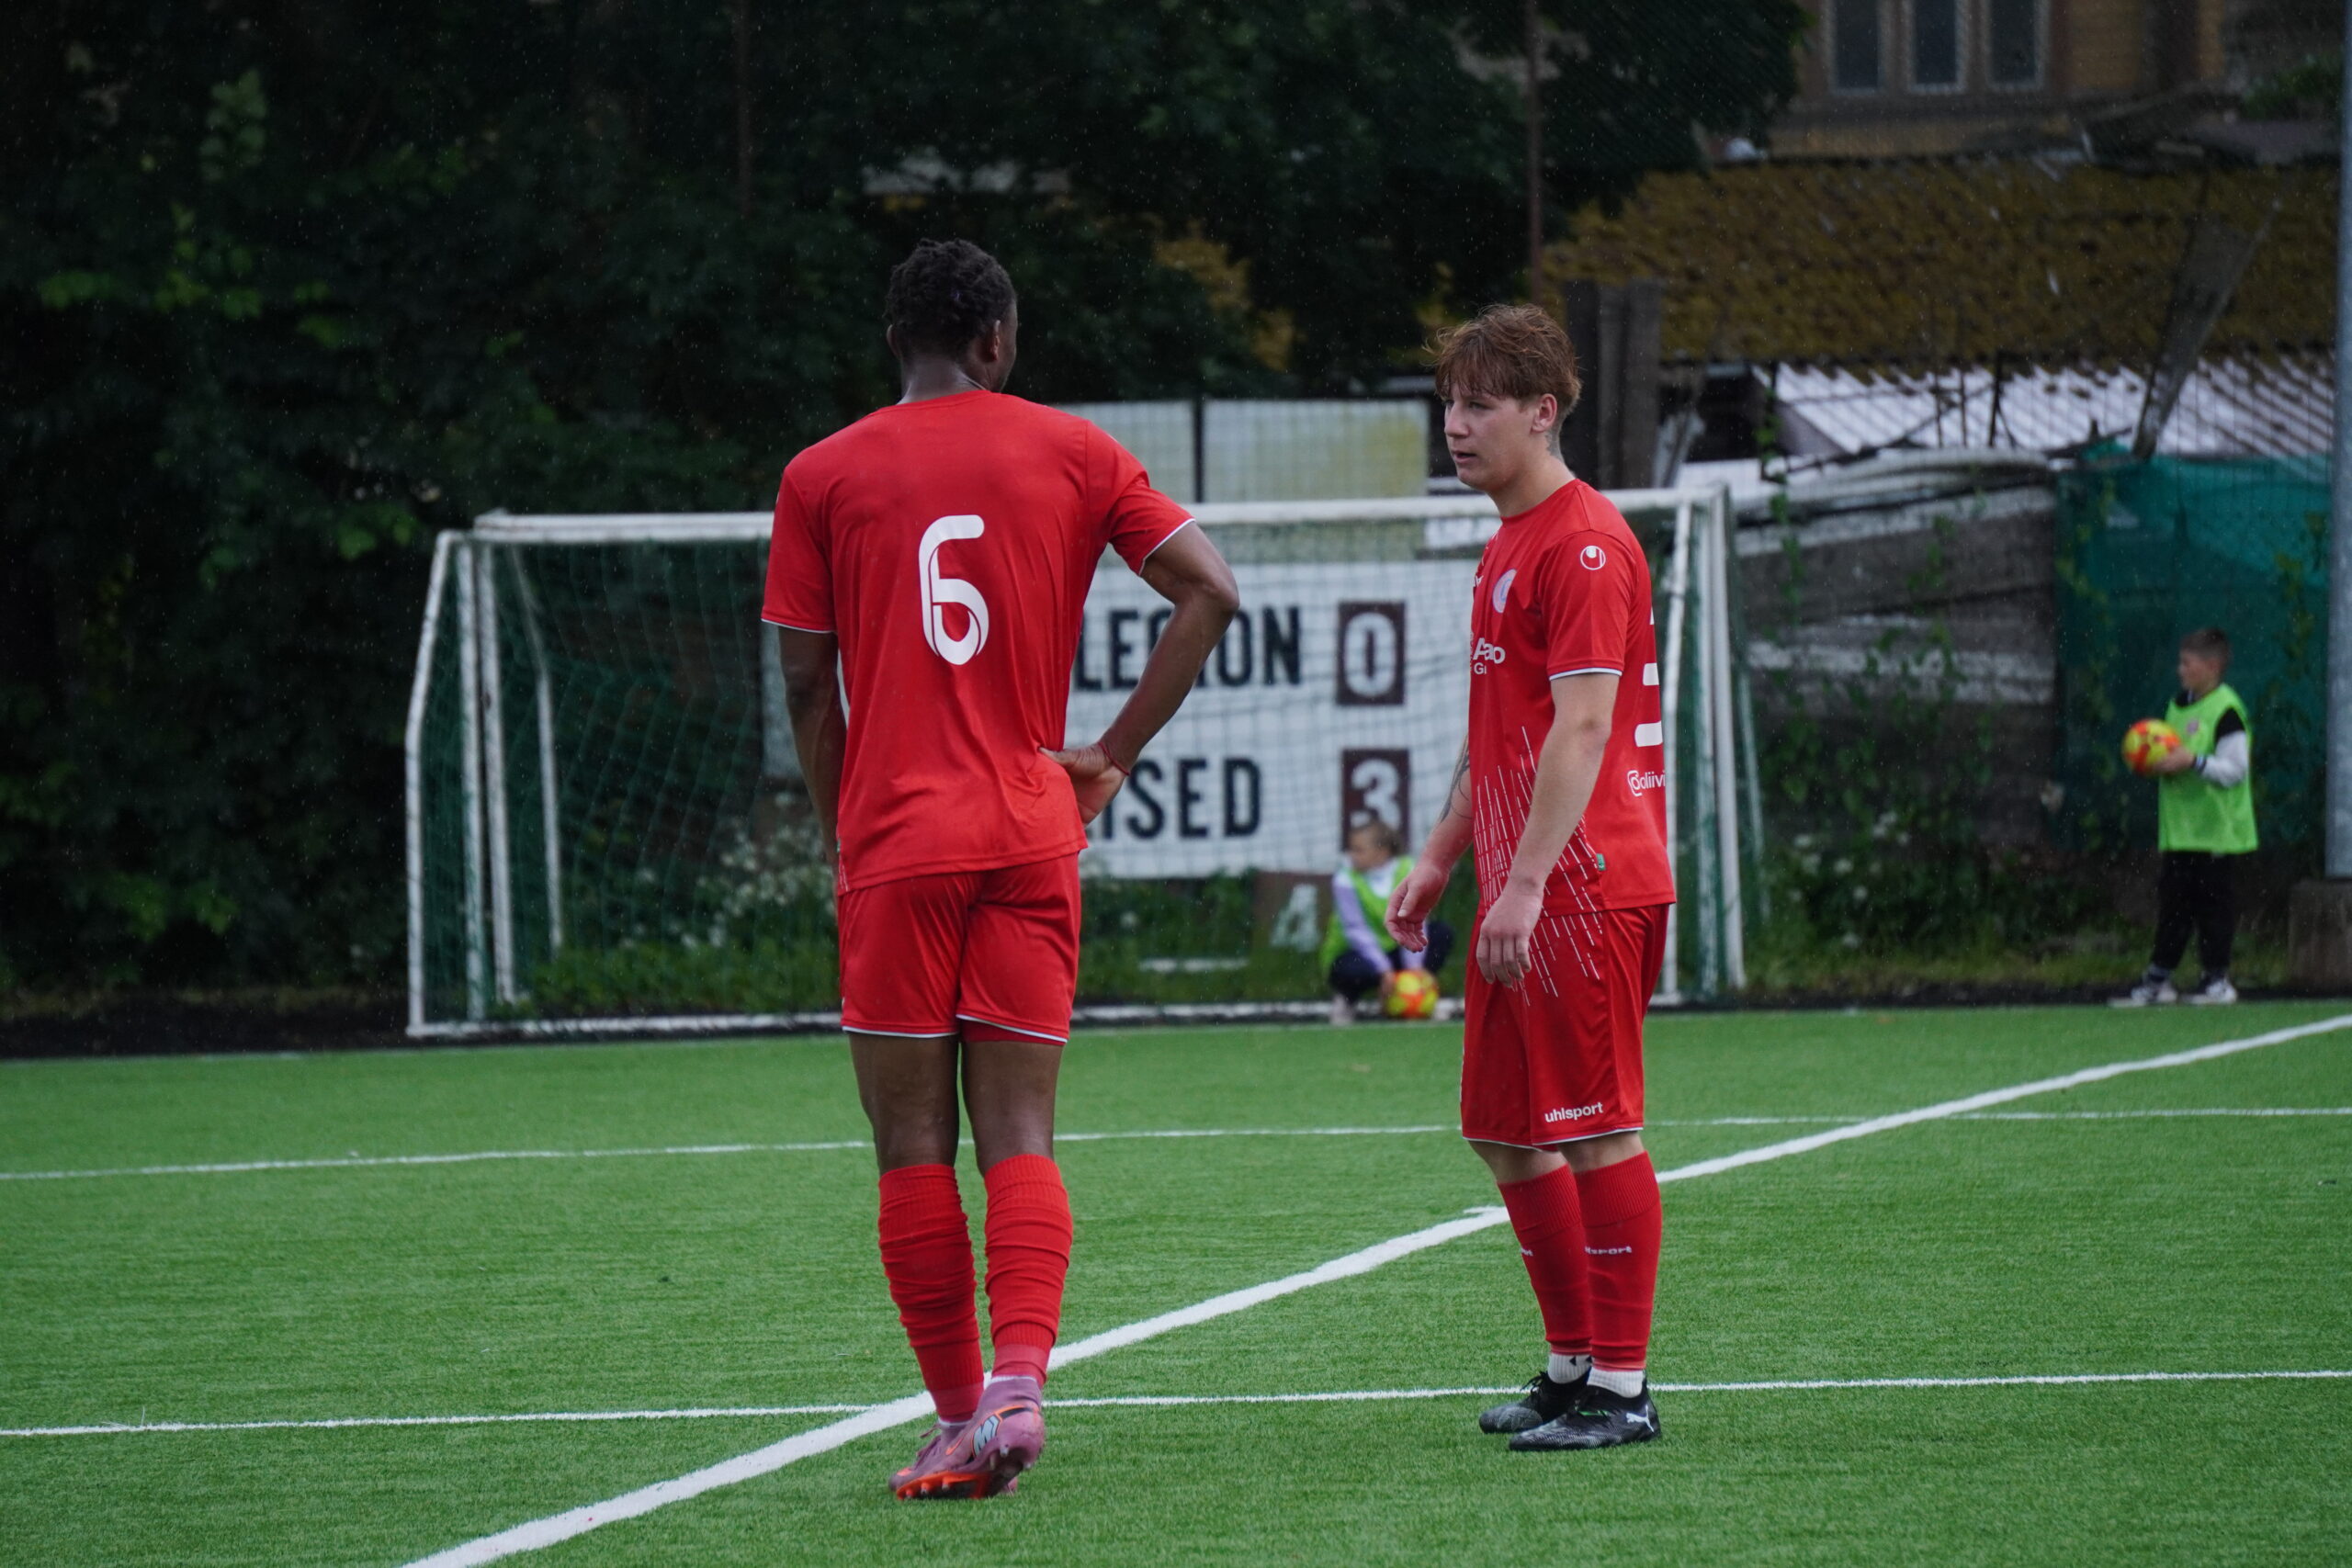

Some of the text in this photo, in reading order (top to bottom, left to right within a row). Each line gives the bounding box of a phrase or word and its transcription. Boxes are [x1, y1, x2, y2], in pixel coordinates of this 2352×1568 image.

[919, 514, 989, 665] 6
[1074, 607, 1301, 691] LEON
[1343, 614, 1399, 696] 0
[1350, 760, 1400, 831] 3
[1544, 1101, 1603, 1122] uhlsport
